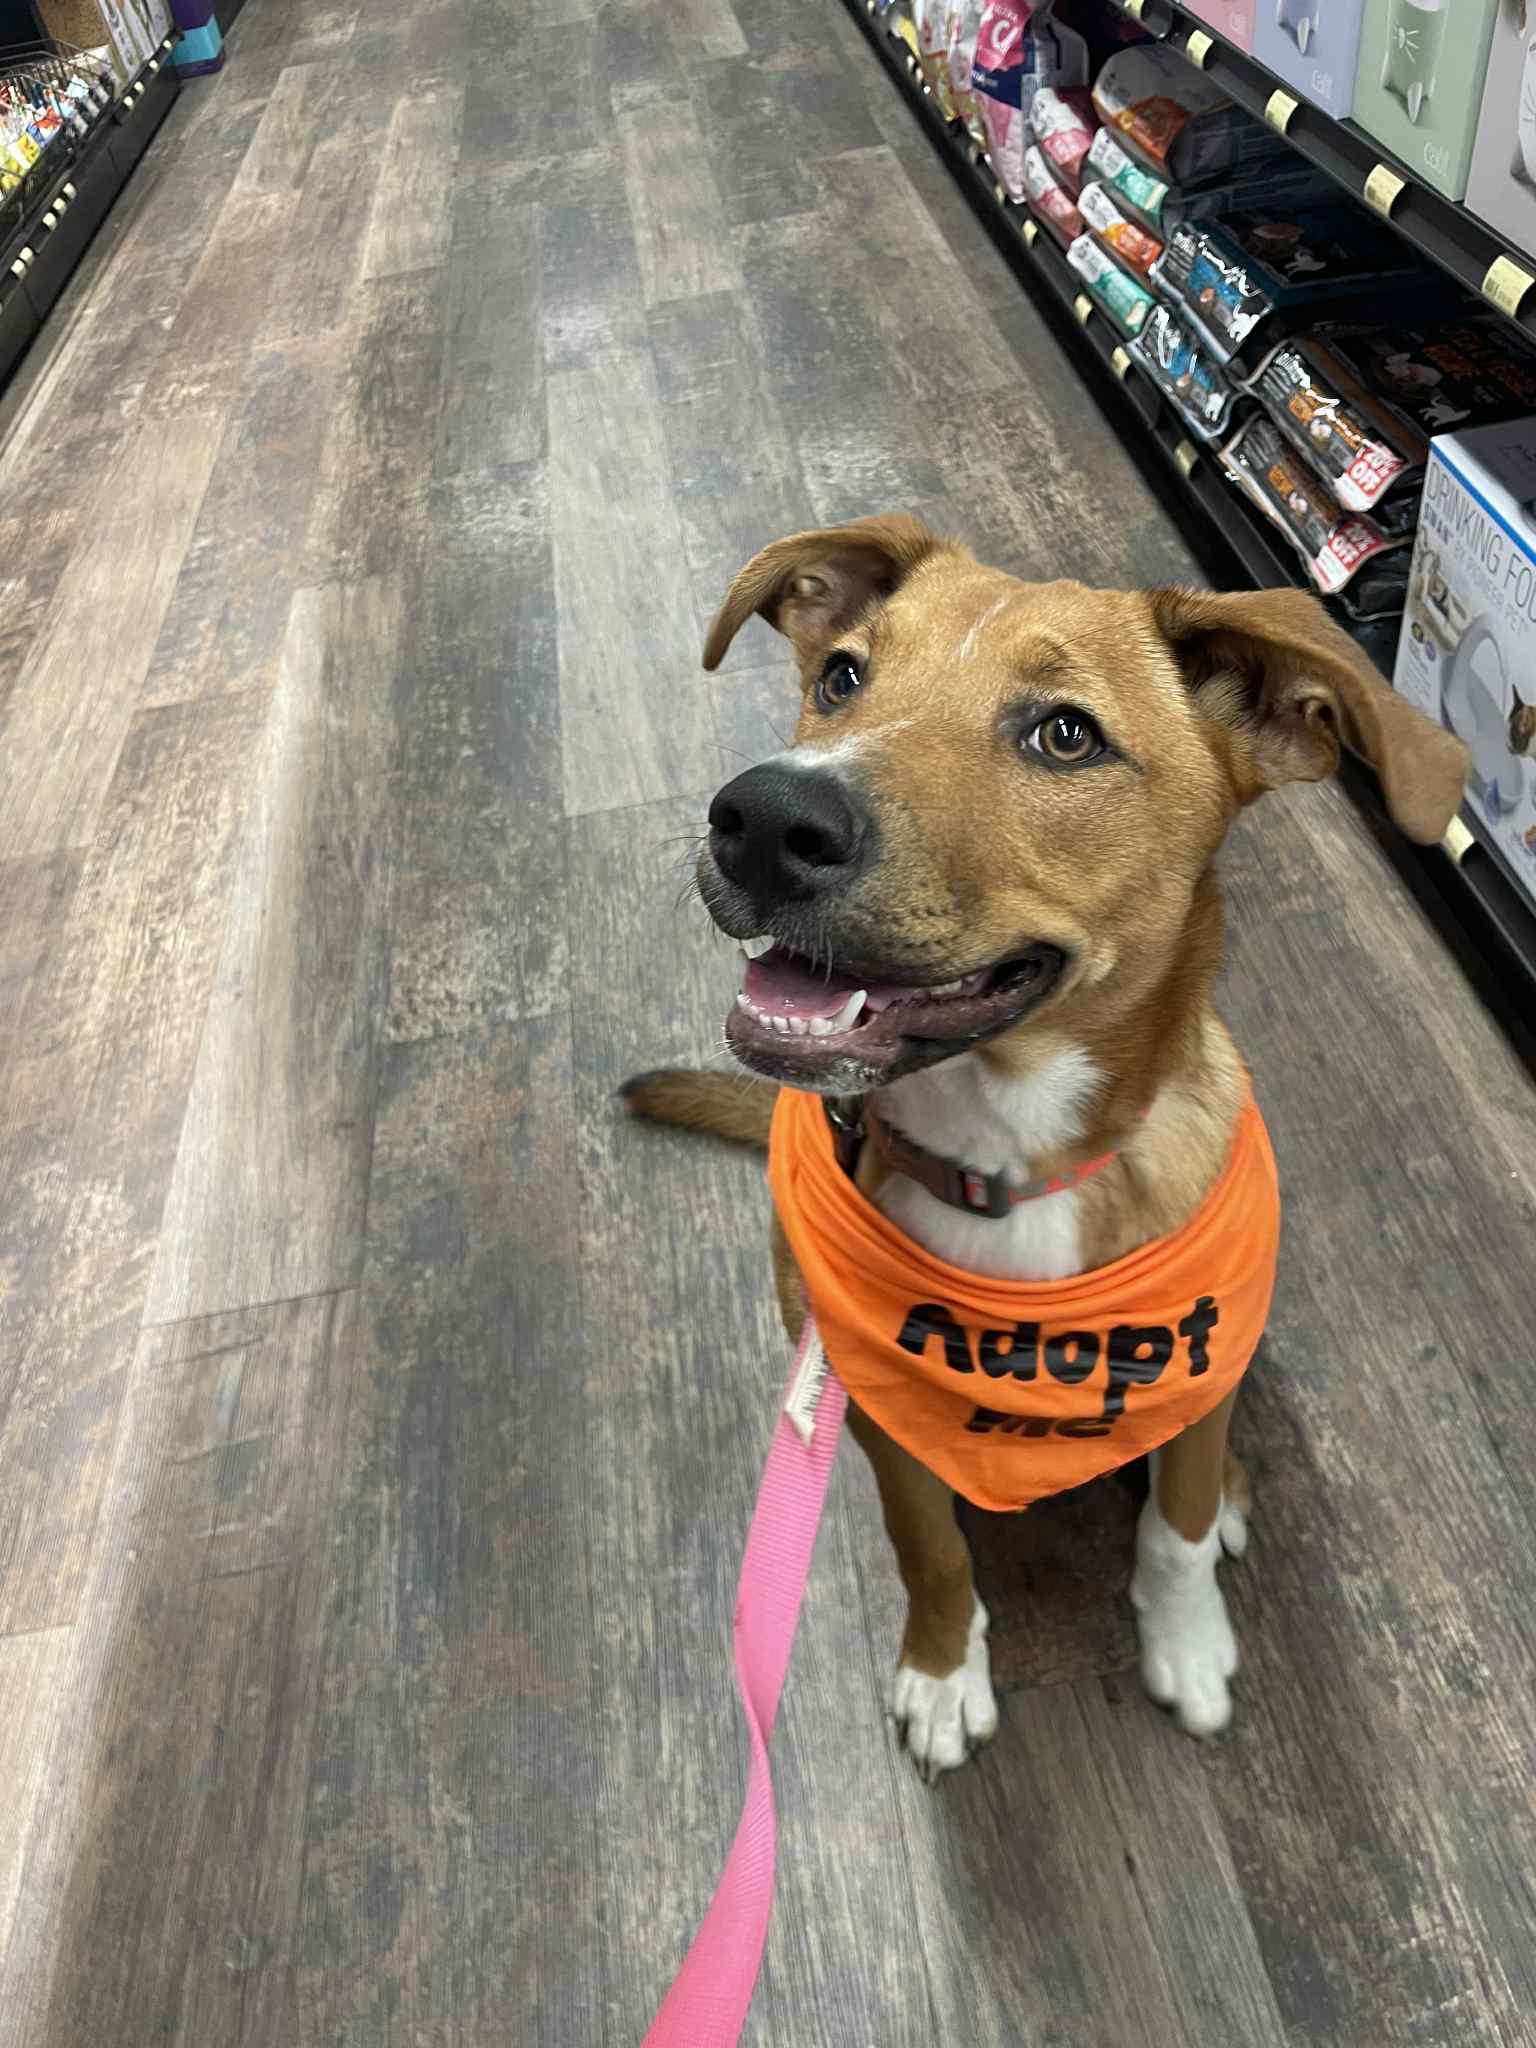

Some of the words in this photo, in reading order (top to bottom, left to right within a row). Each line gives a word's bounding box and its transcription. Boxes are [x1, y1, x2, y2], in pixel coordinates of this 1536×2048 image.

[1350, 460, 1381, 495] OFF
[1331, 534, 1361, 565] OFF
[1426, 462, 1503, 577] DRINKING
[896, 1295, 1219, 1418] Adopt
